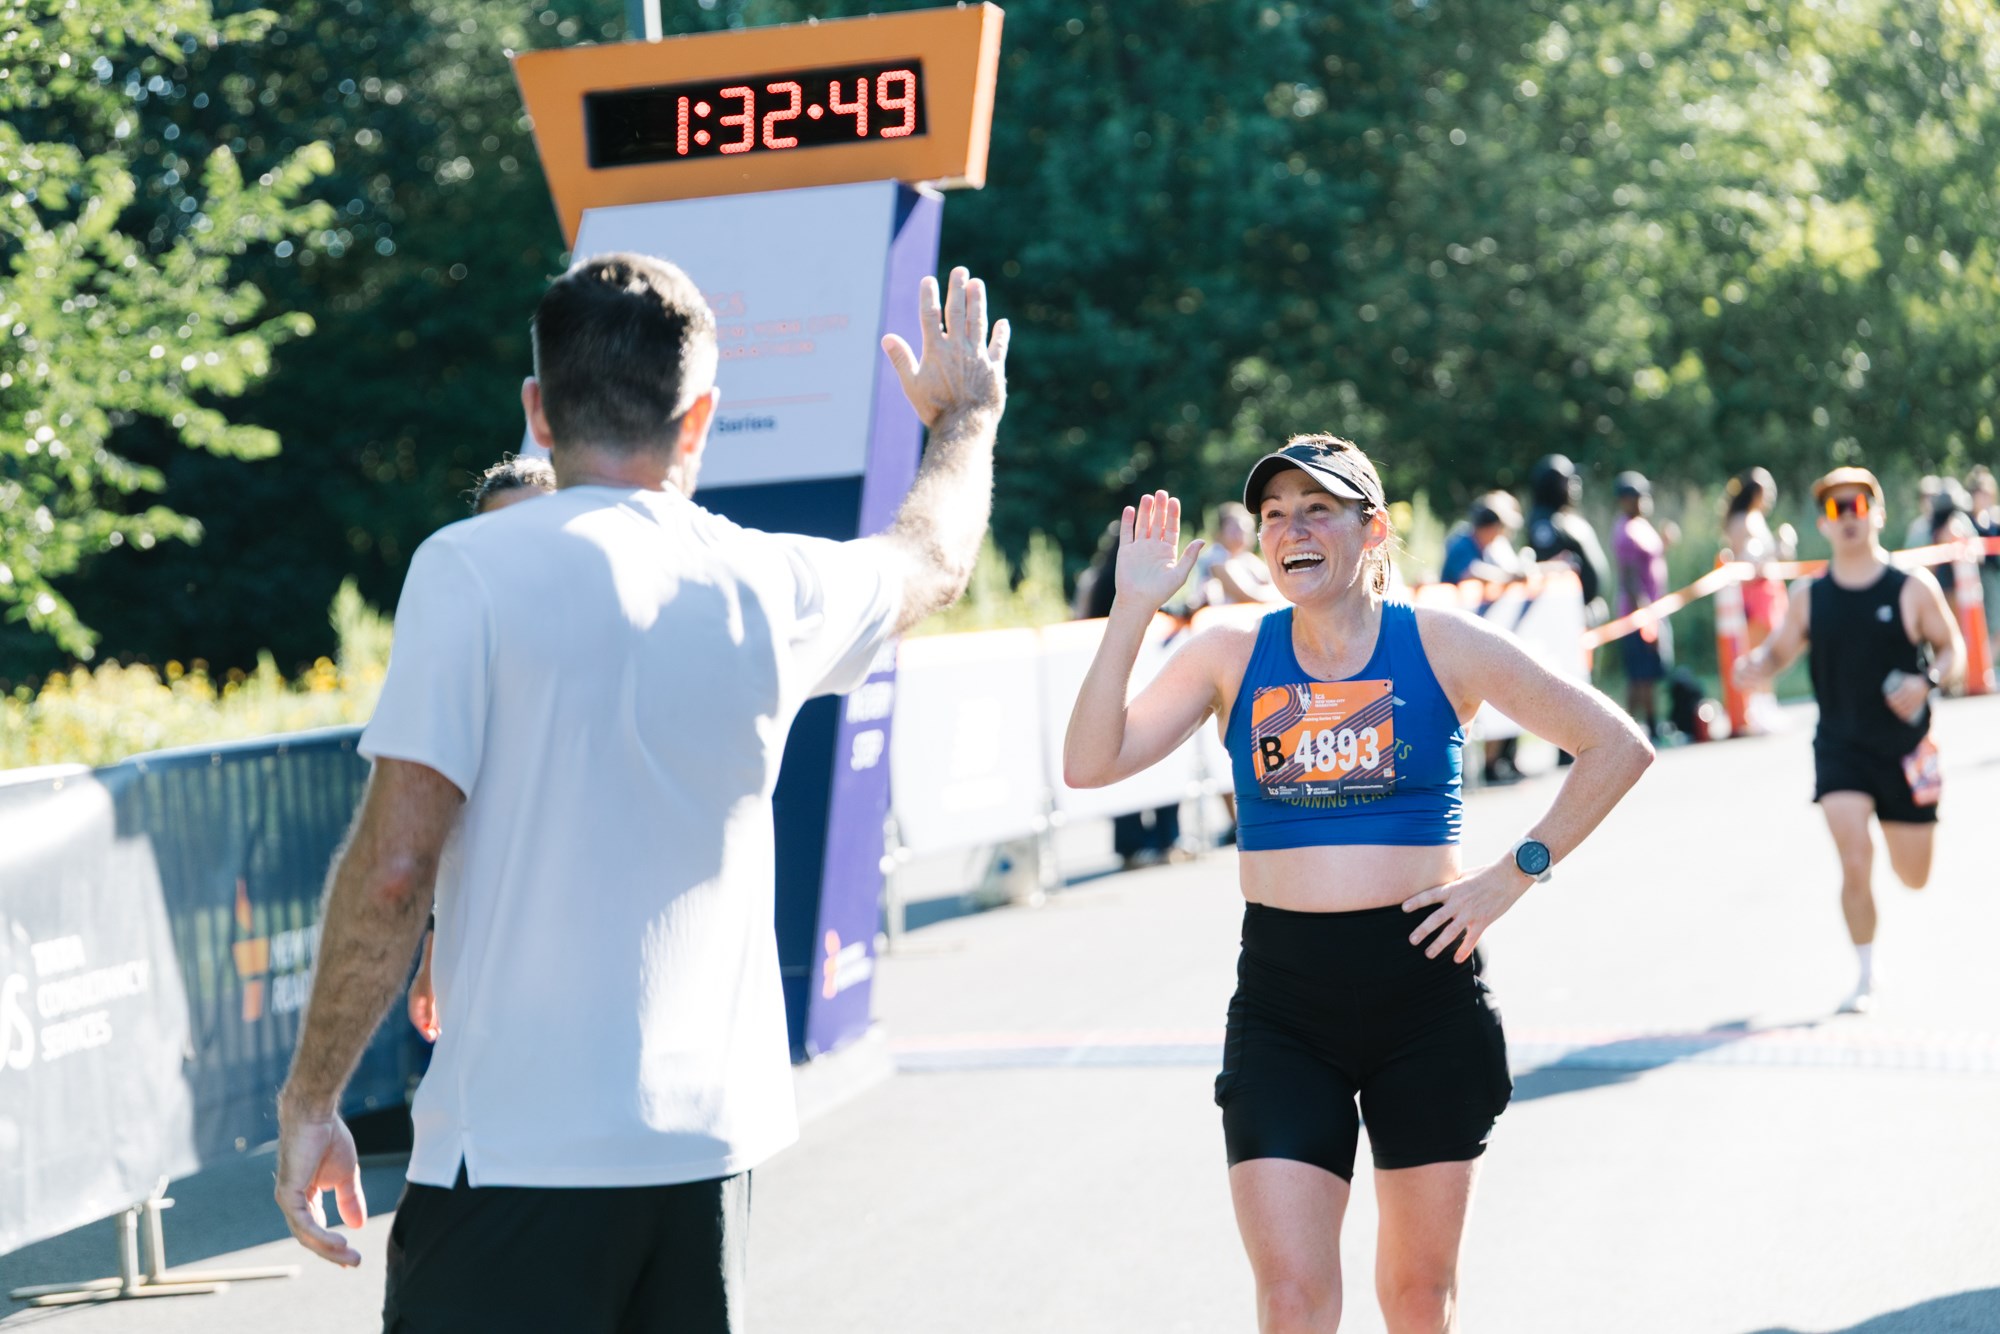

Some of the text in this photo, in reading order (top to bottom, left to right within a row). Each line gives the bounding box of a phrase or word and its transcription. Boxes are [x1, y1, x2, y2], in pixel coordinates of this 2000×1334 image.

[717, 413, 776, 434] Series
[1259, 726, 1381, 774] B 4893
